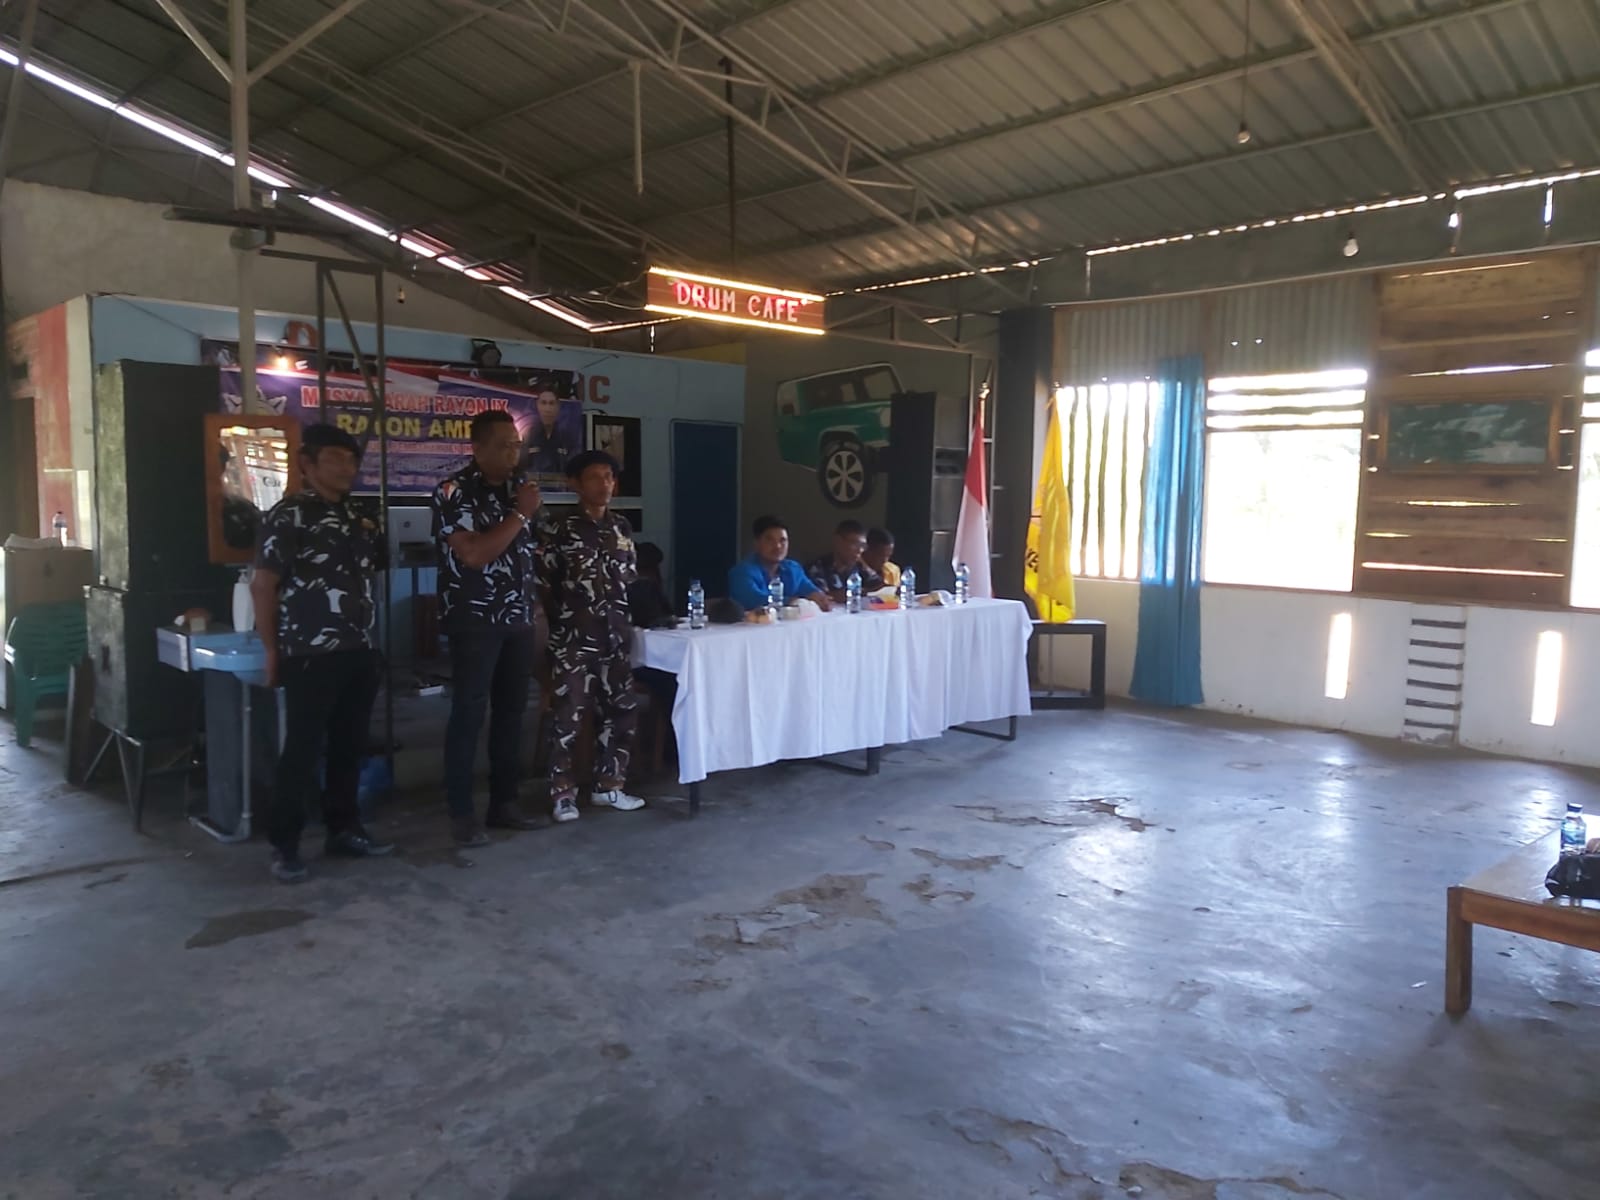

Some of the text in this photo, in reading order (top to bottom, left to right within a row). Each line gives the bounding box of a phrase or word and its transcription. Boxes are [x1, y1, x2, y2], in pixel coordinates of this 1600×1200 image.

[676, 281, 800, 323] DRUM CAFE
[433, 394, 488, 416] RAYON
